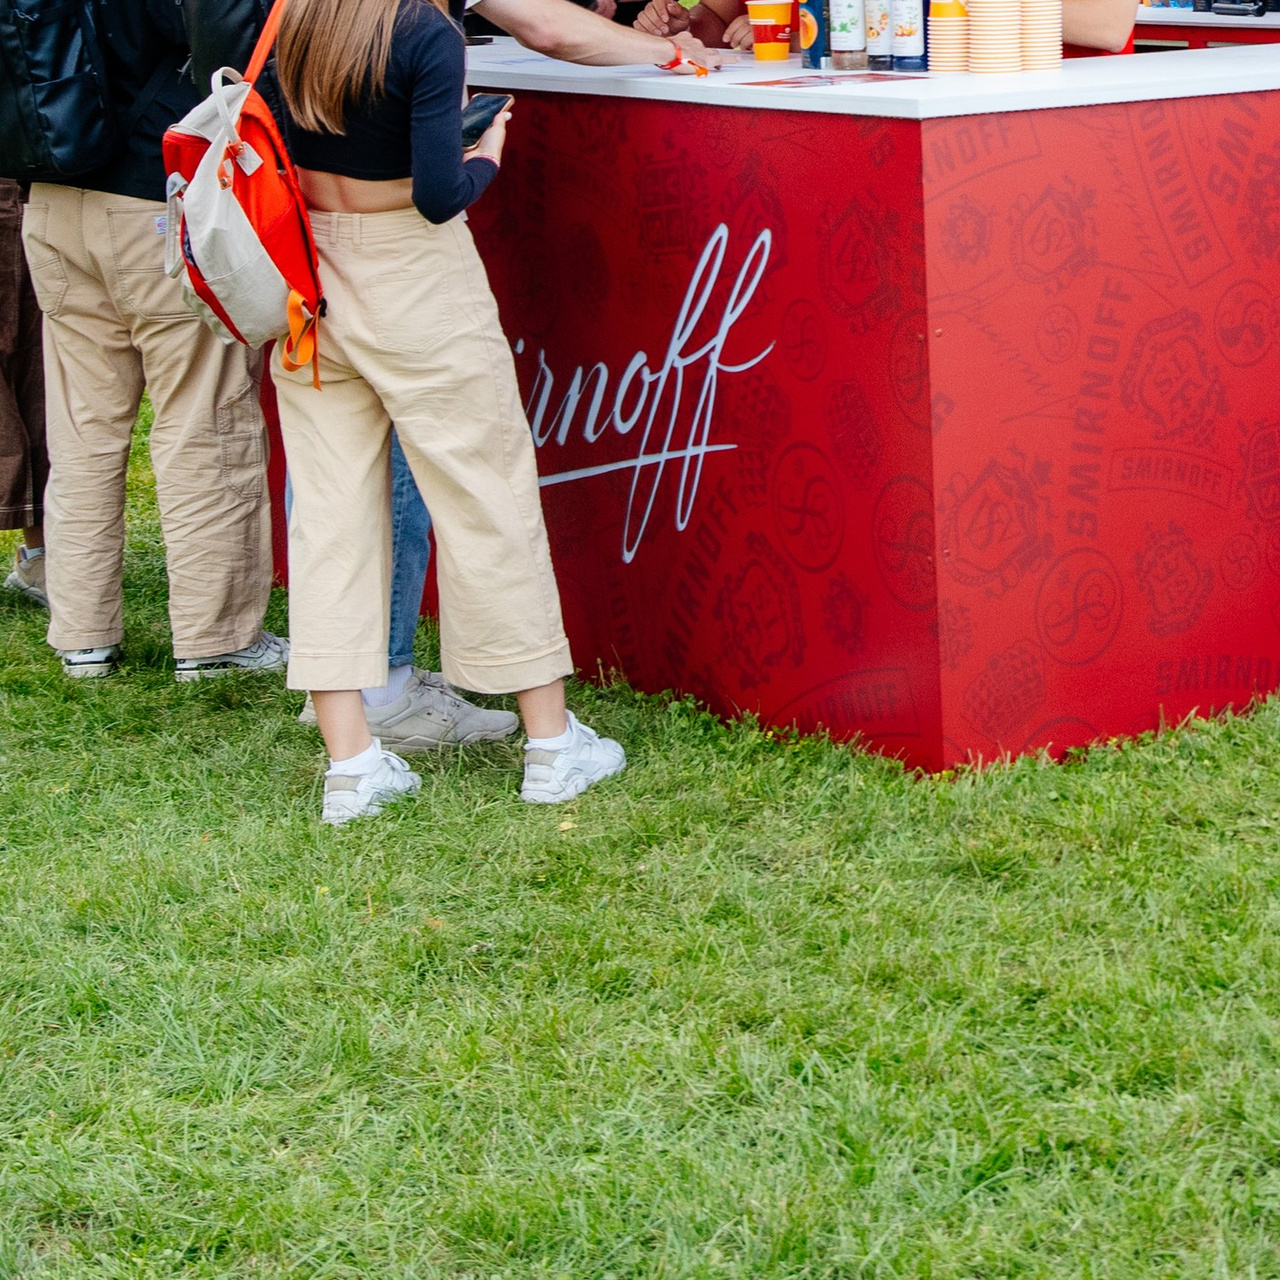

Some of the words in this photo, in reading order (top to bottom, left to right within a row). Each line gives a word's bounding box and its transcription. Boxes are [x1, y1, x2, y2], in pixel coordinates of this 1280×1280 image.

[515, 222, 776, 563] rnoff
[1066, 275, 1134, 539] SMIRNOFF
[1121, 456, 1223, 493] SMIRNOFF
